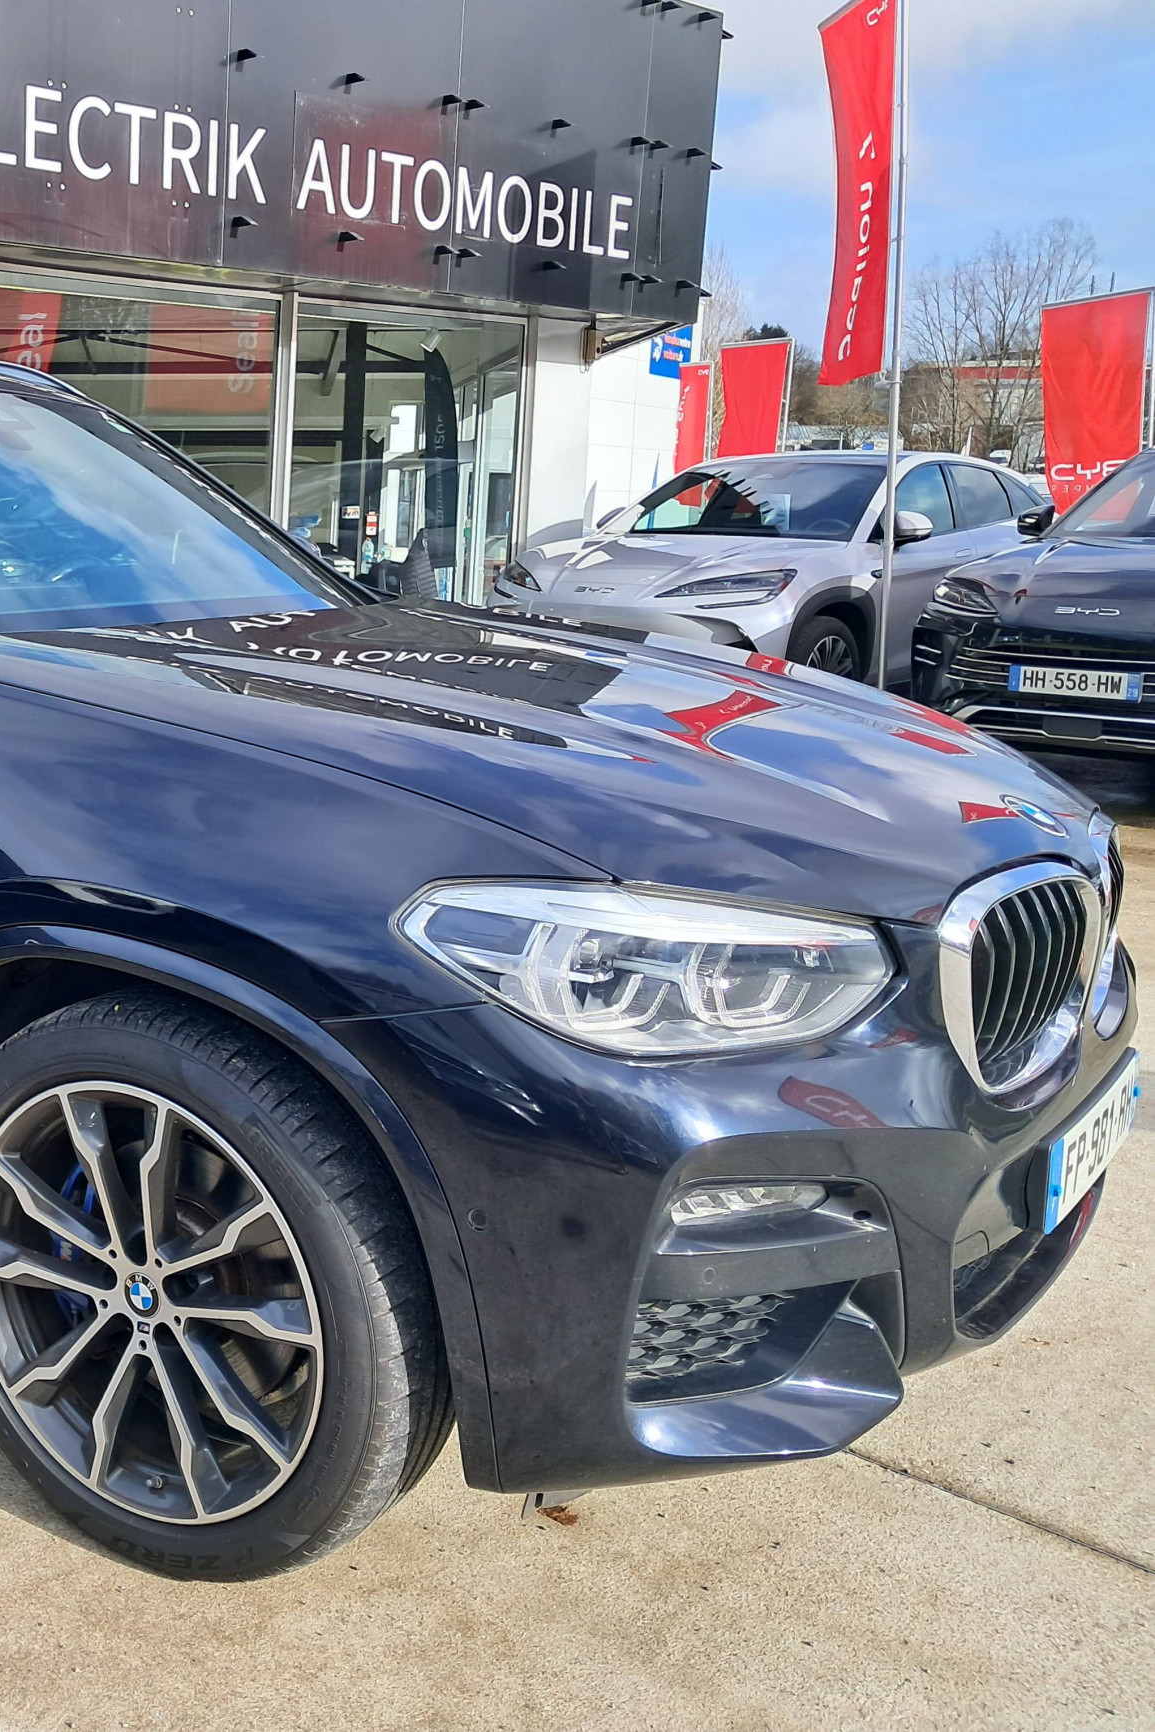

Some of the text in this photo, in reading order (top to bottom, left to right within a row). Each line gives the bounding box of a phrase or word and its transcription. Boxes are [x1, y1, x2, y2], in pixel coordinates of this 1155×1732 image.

[296, 138, 633, 260] AUTOMOBILE
[573, 585, 616, 594] BYD
[1054, 605, 1121, 617] BYD
[1022, 669, 1123, 695] HH-558-HW
[1127, 688, 1139, 698] 29
[125, 1274, 156, 1291] BMW
[110, 1536, 221, 1570] ZERO
